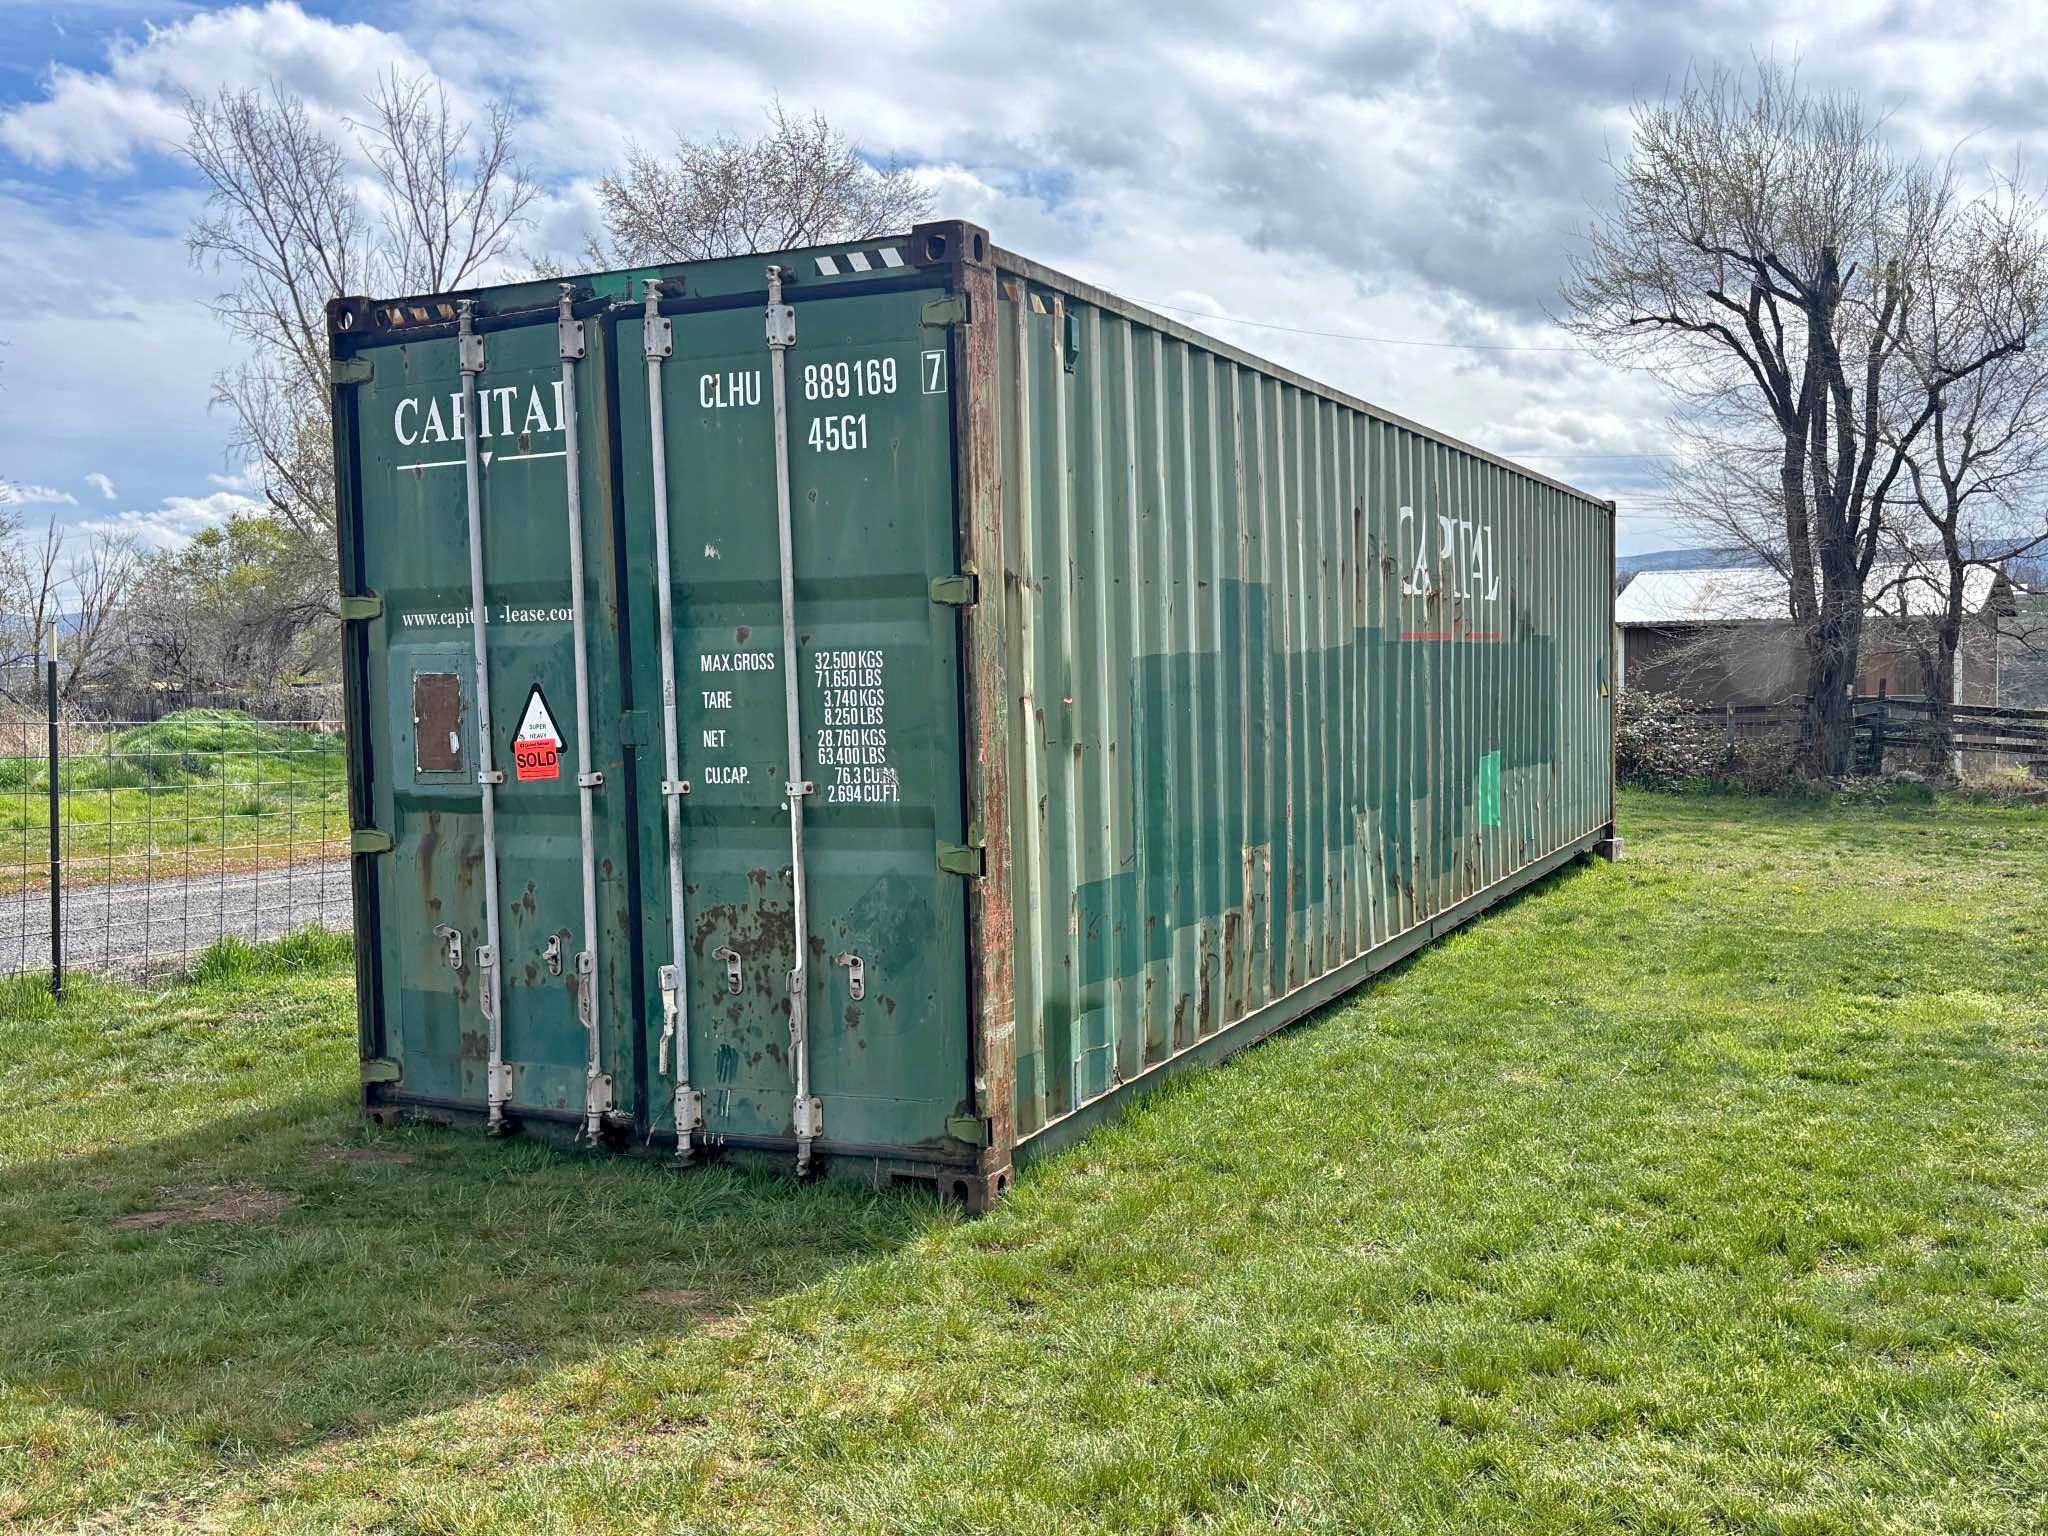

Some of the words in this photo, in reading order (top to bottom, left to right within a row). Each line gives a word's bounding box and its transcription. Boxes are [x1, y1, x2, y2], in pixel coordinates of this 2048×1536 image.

[700, 370, 761, 408] CLHU
[804, 357, 897, 400] 889169
[926, 353, 941, 391] 7
[808, 413, 868, 452] 45G1
[701, 653, 775, 672] MAX.GROSS
[815, 651, 856, 670] 32.500
[858, 650, 884, 669] KGS
[815, 669, 857, 688] 71.650
[859, 669, 882, 687] LBS
[701, 691, 733, 709] TARE
[824, 689, 857, 708] 3.740
[859, 688, 885, 707] KGS
[824, 707, 858, 726] 8.250
[860, 707, 884, 725] LBS
[703, 729, 726, 748] NET
[817, 729, 859, 747] 28.760
[861, 728, 887, 746] KGS
[516, 751, 557, 768] SOLD
[818, 747, 860, 765] 63.400
[862, 746, 886, 764] LBS
[705, 766, 751, 784] CU.CAP.
[834, 766, 861, 785] 76.3
[827, 785, 861, 803] 2.694
